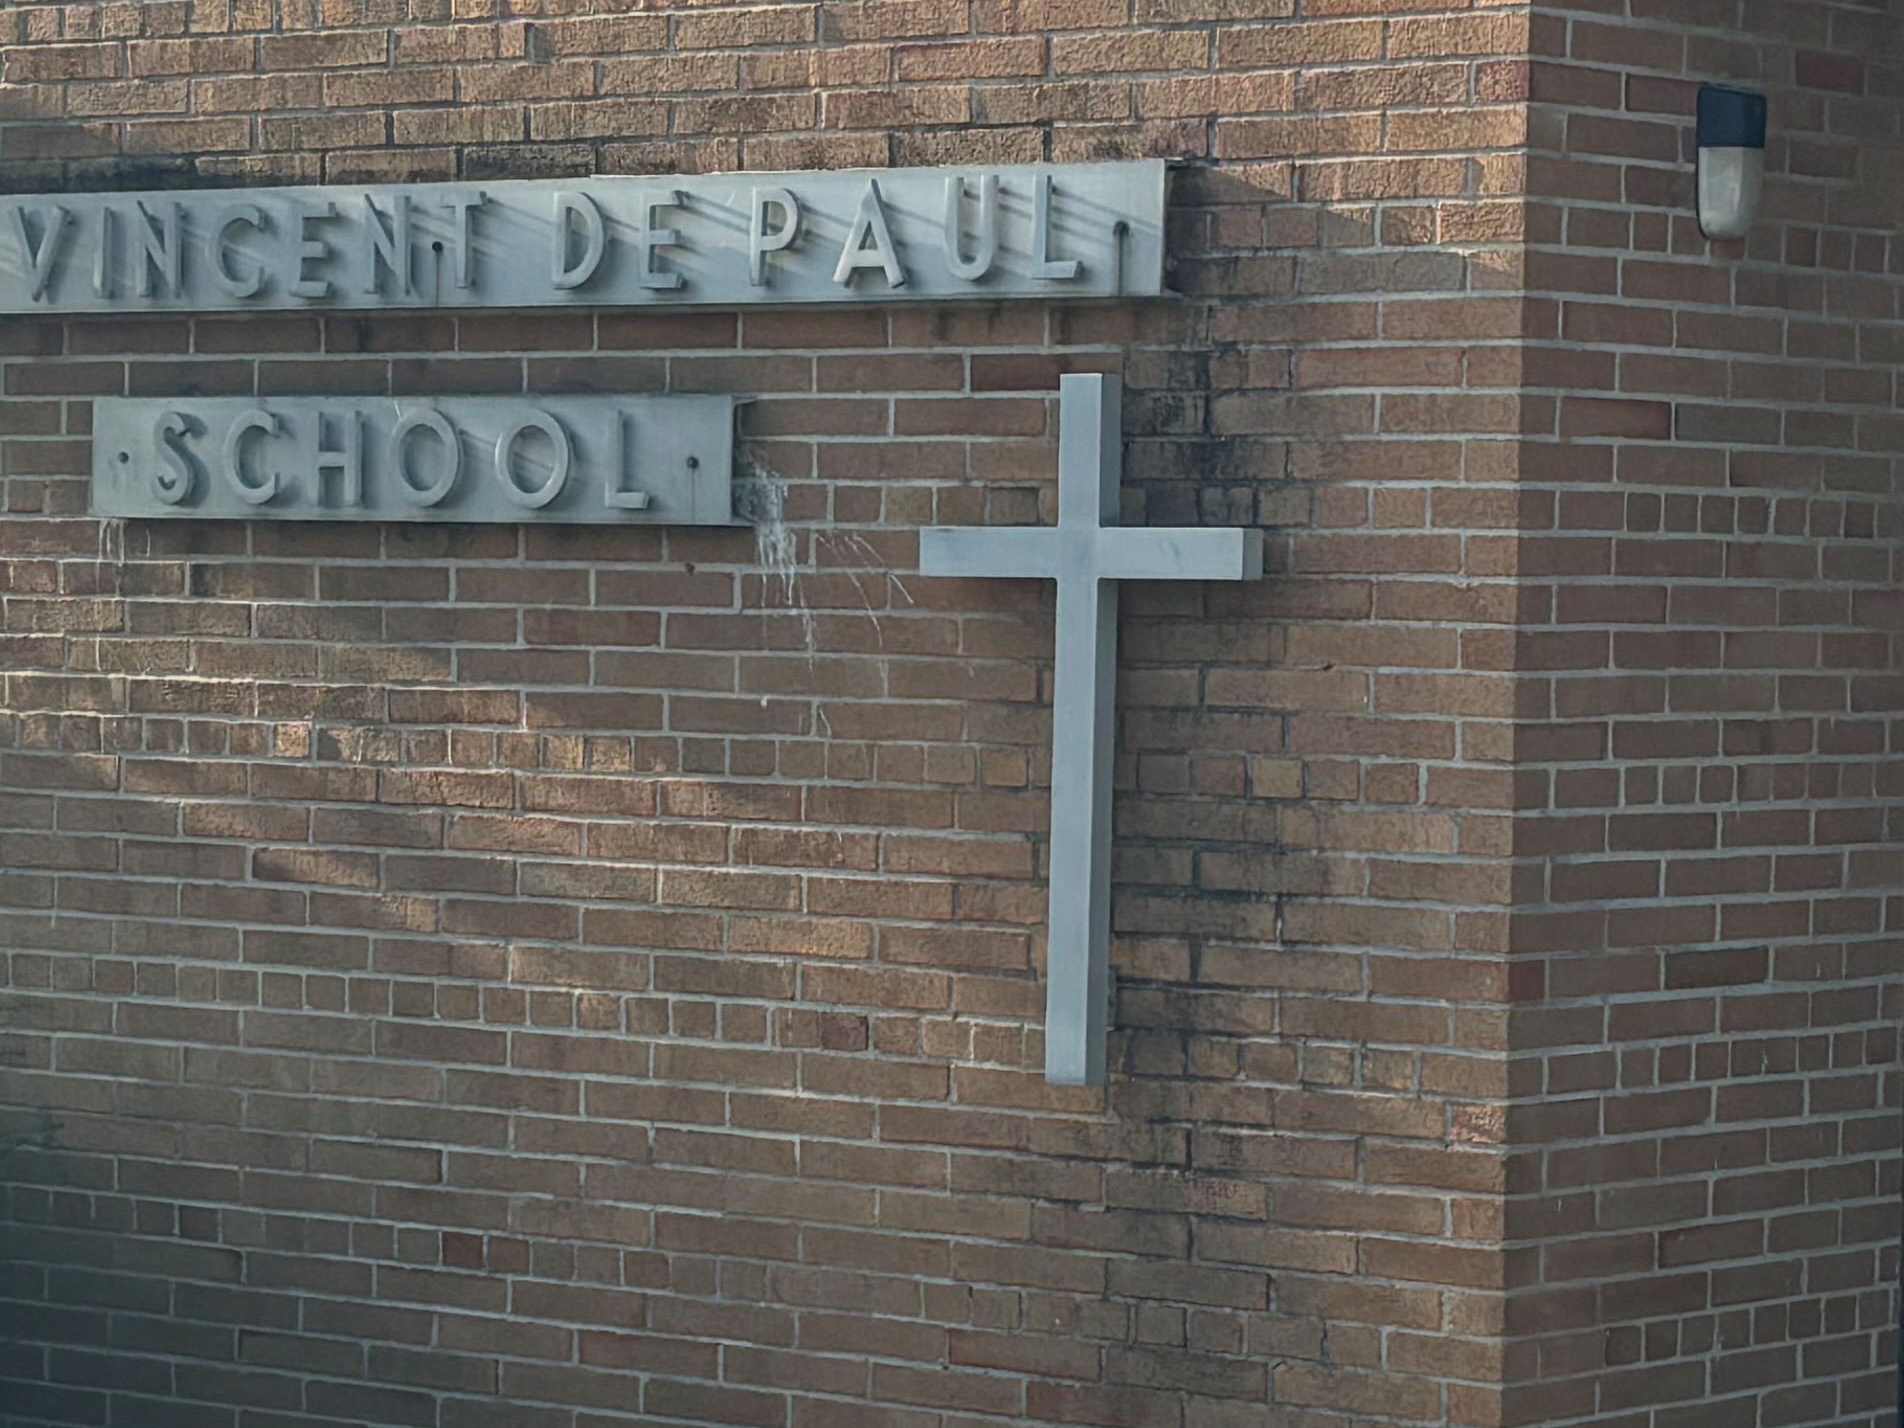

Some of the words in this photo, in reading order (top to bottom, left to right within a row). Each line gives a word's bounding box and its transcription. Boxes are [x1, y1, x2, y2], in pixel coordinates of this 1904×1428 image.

[8, 190, 490, 303] VINCENT
[552, 188, 686, 290] DE
[748, 174, 1084, 289] PAUL
[152, 407, 650, 509] SCHOOL
